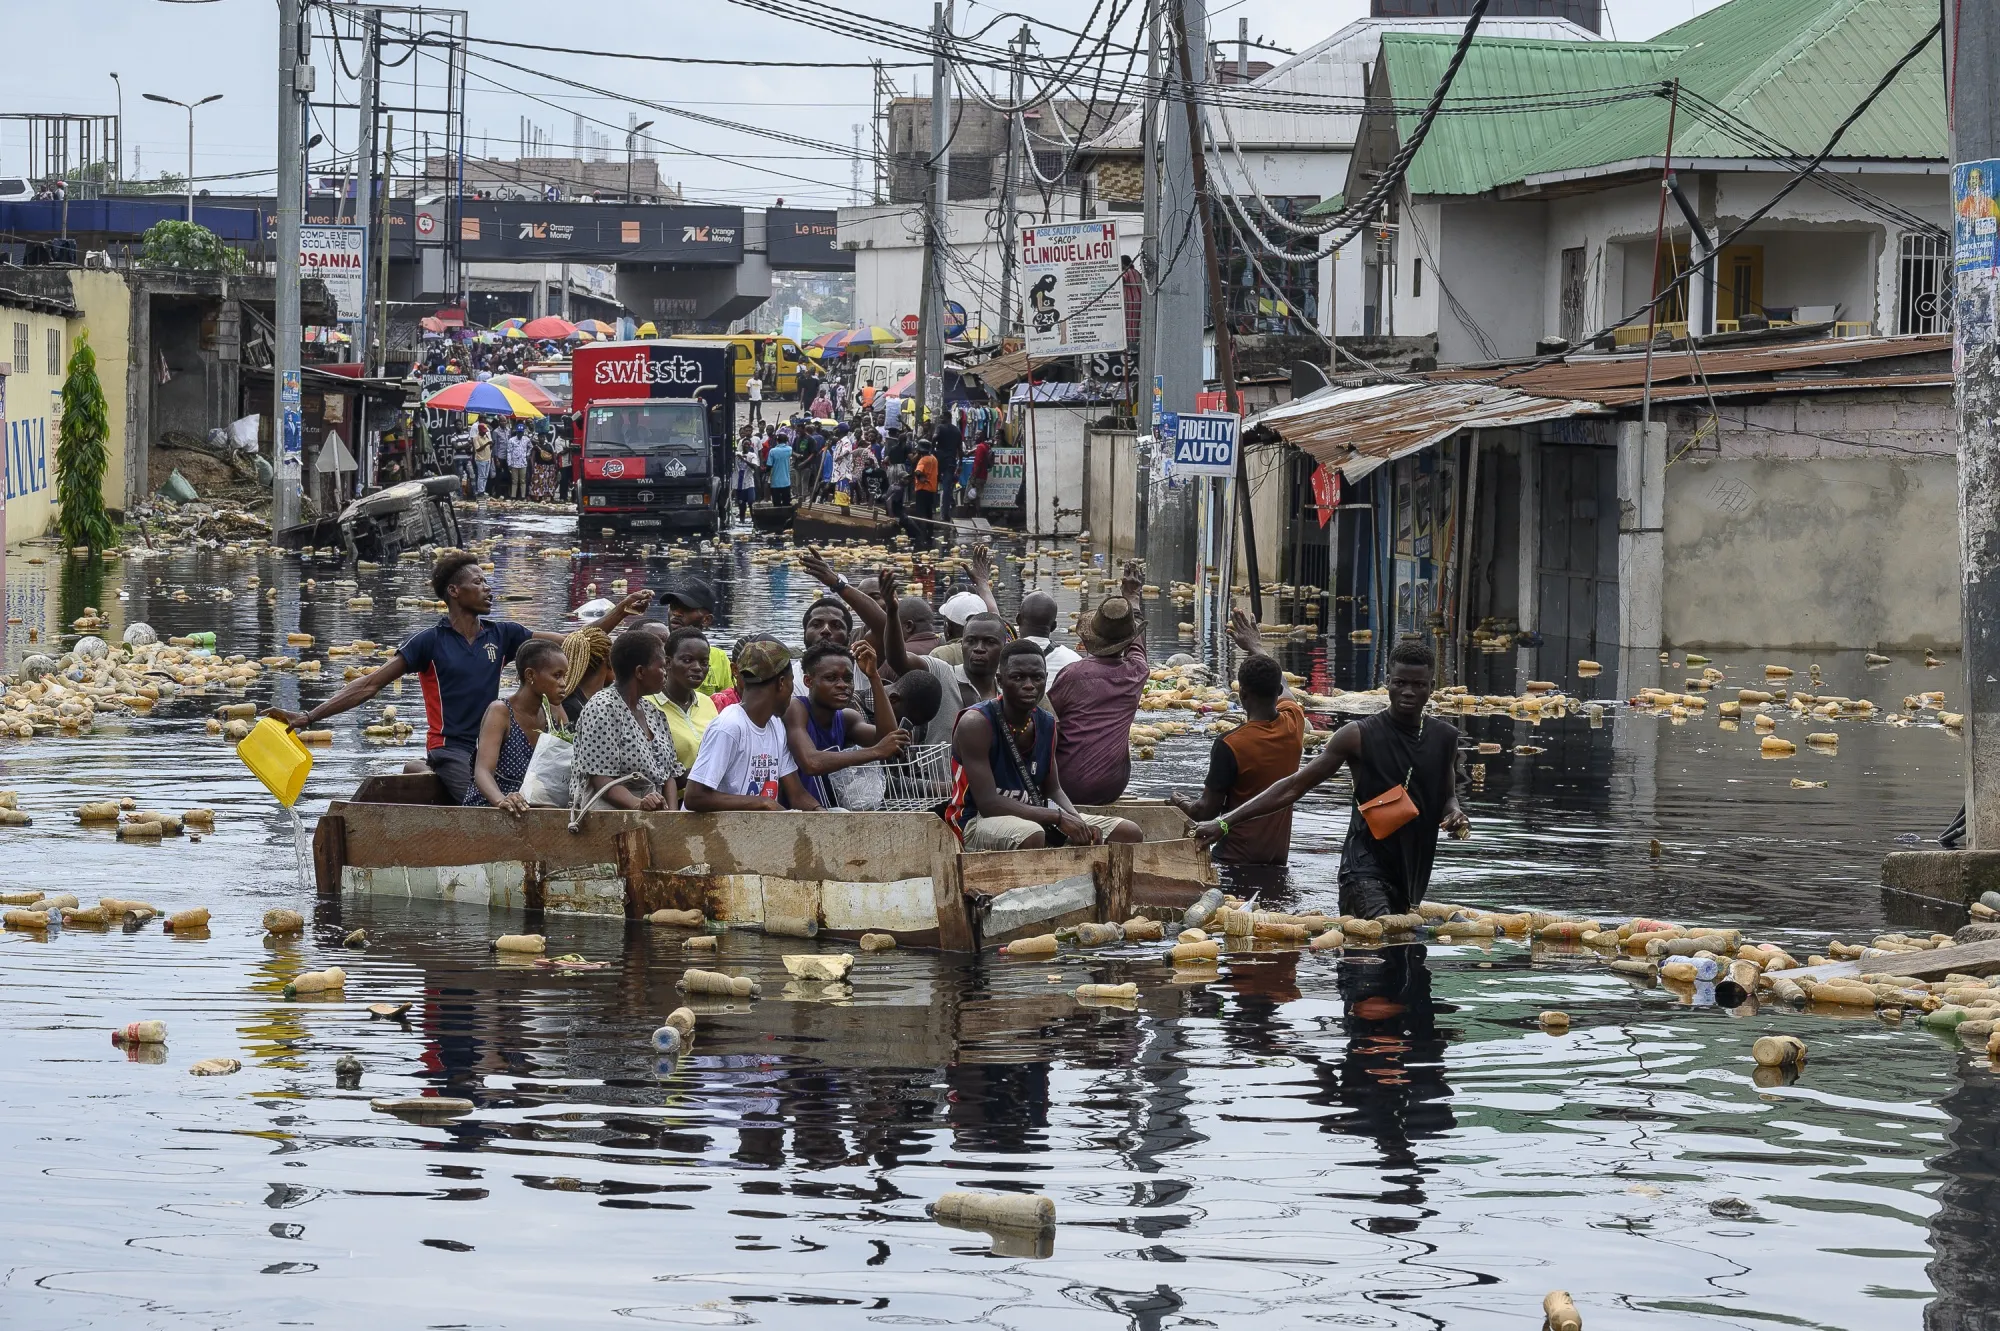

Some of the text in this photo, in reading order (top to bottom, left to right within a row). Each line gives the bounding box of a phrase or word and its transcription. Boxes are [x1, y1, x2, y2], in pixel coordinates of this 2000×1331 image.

[550, 223, 574, 232] Orange
[712, 228, 735, 236] Orange
[795, 222, 809, 234] Le
[1052, 224, 1071, 236] SALUT
[1072, 225, 1081, 235] DU
[1083, 224, 1102, 233] CONGO
[1103, 224, 1115, 240] H
[300, 230, 348, 240] COMPLEXE
[550, 231, 572, 240] Money
[712, 235, 733, 244] Money
[1023, 229, 1035, 247] H
[302, 240, 346, 249] SCOLAIRE
[1023, 244, 1076, 264] CLINIQUE
[1094, 241, 1113, 260] FOI
[300, 252, 361, 268] OSANNA
[595, 353, 702, 384] swissta
[1178, 419, 1234, 442] FIDELITY
[1177, 442, 1230, 463] AUTO
